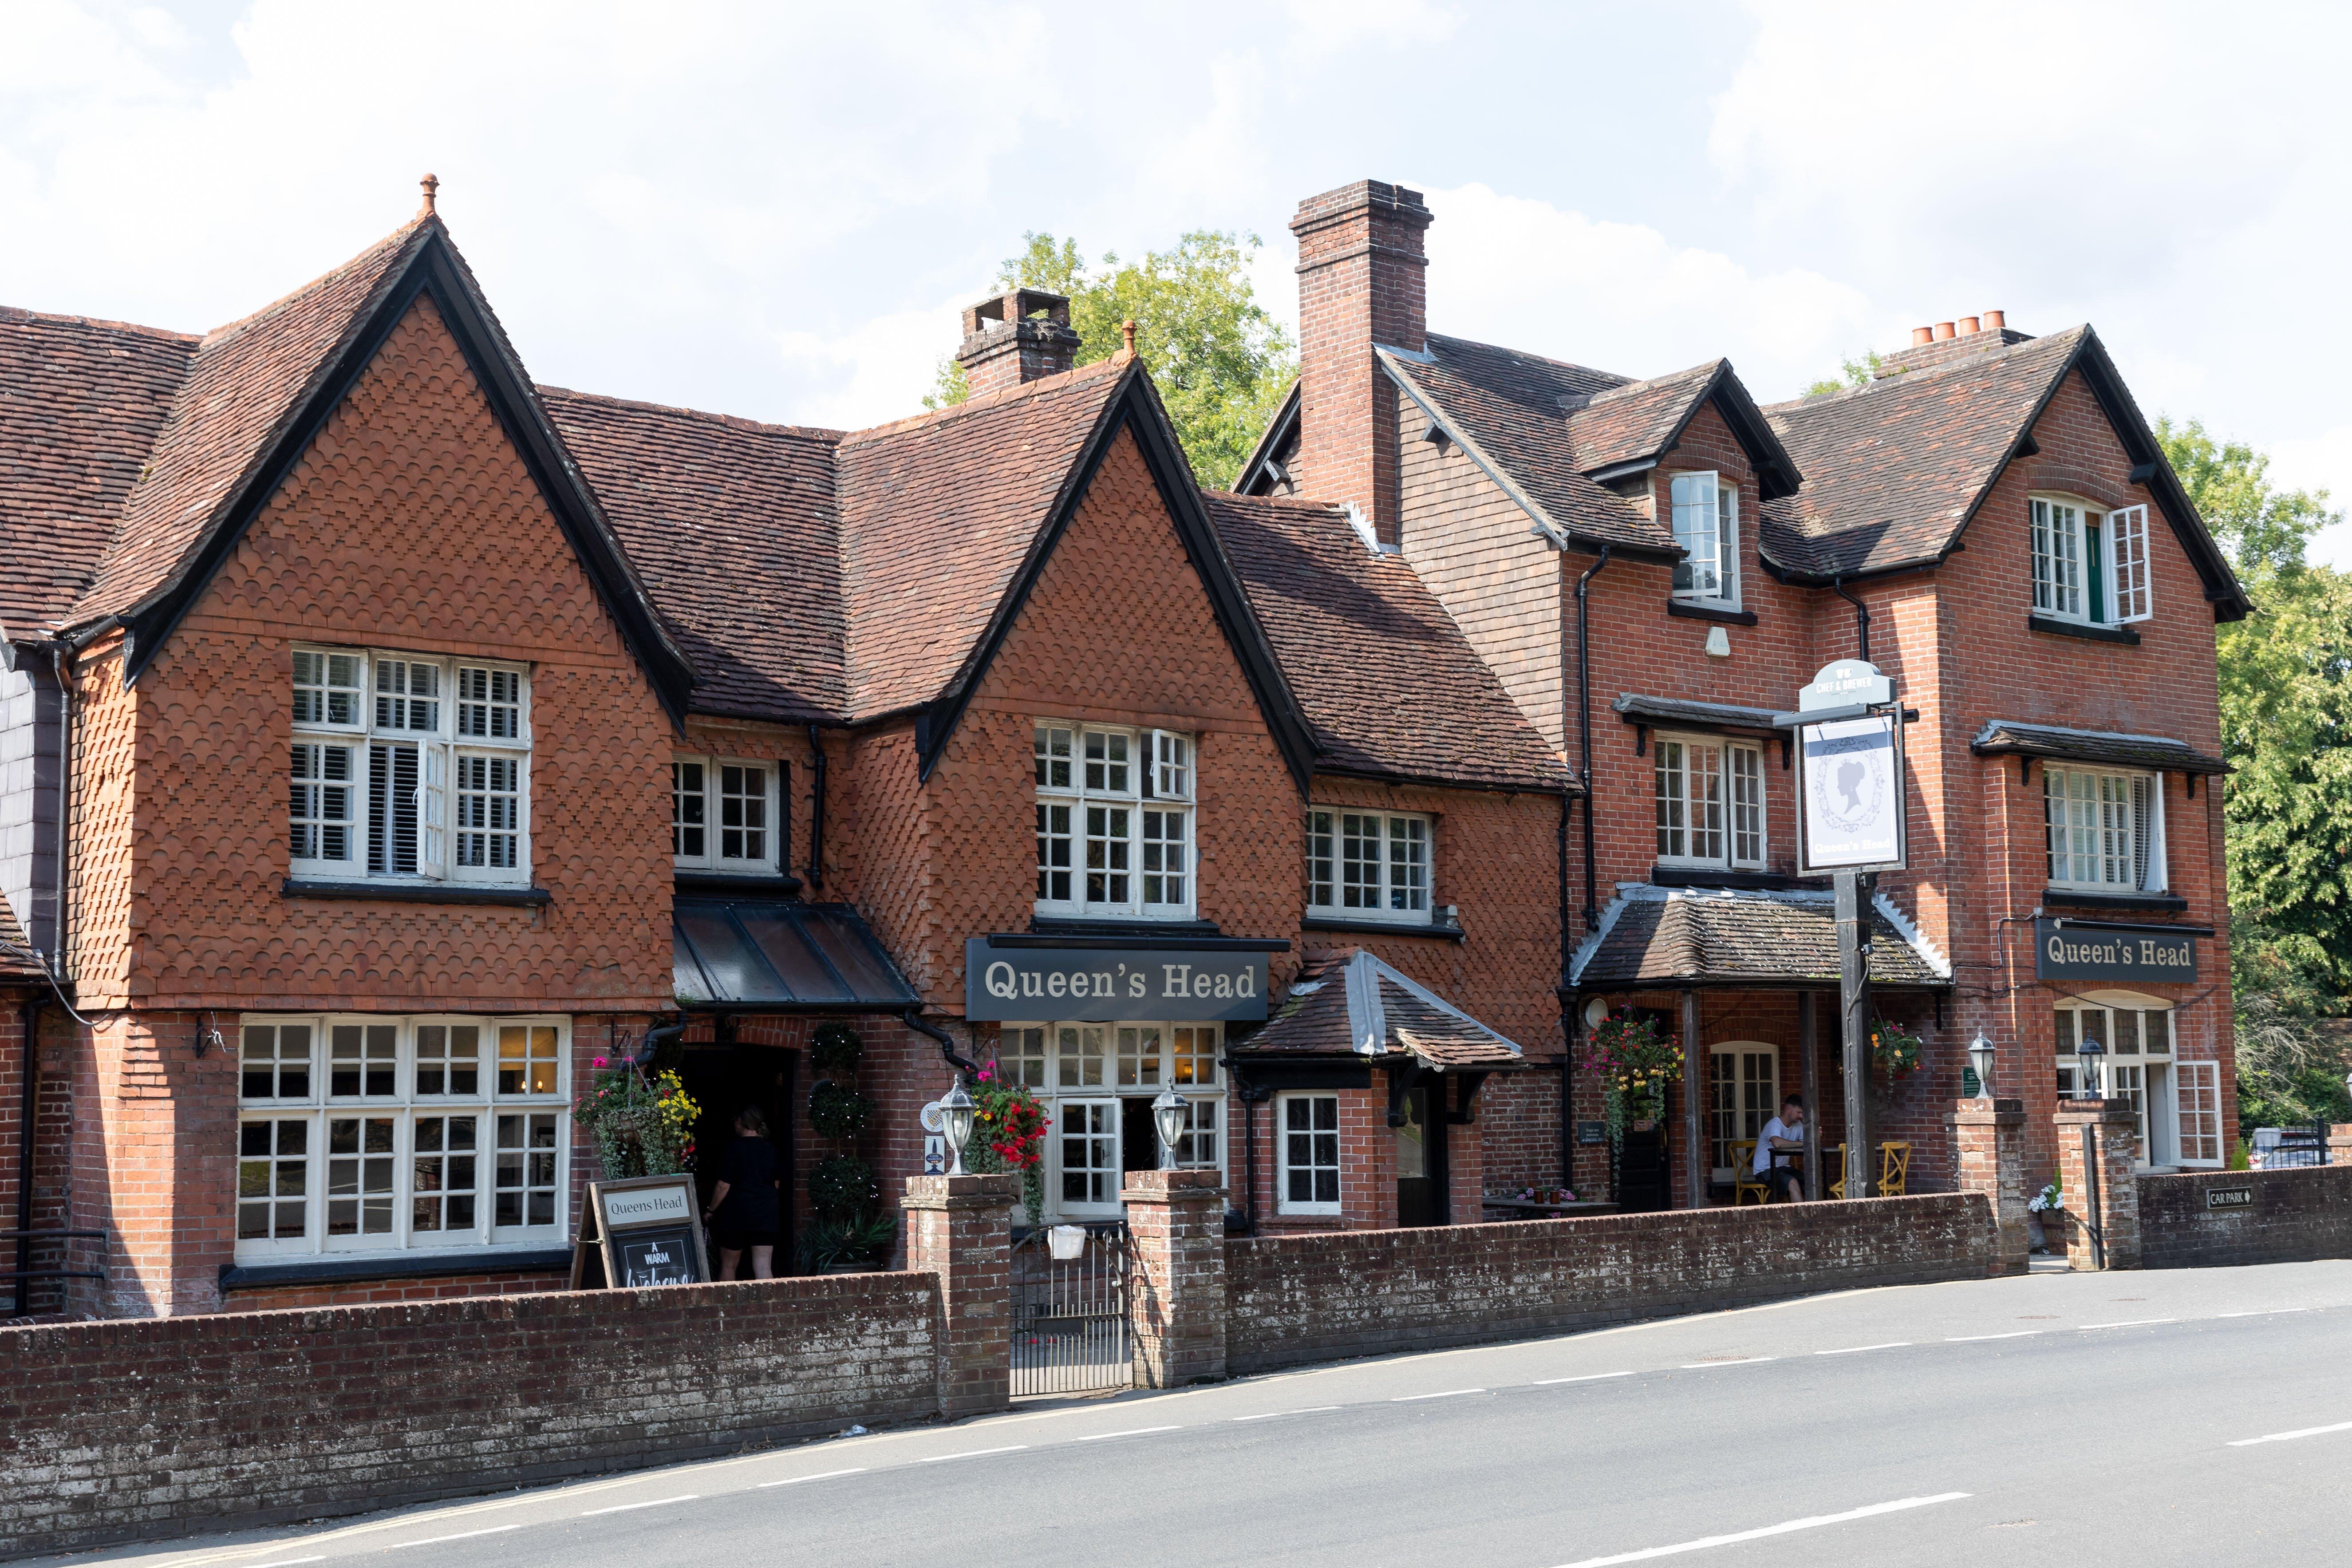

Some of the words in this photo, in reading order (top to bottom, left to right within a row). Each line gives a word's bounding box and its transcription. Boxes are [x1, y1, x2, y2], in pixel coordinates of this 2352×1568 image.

[1816, 681, 1834, 694] CHEF
[1835, 681, 1841, 691] &
[1843, 677, 1872, 690] BREWER
[1814, 840, 1859, 854] Queen's
[1862, 838, 1891, 850] Head
[2048, 936, 2133, 964] Queen's
[2139, 940, 2191, 967] Head
[985, 961, 1146, 999] Queen's
[1162, 964, 1256, 998] Head
[611, 1203, 652, 1215] Queens
[654, 1196, 682, 1210] Head
[2210, 1193, 2226, 1204] CAR
[2226, 1192, 2244, 1203] PARK
[652, 1242, 658, 1252] A
[644, 1252, 670, 1265] WARM
